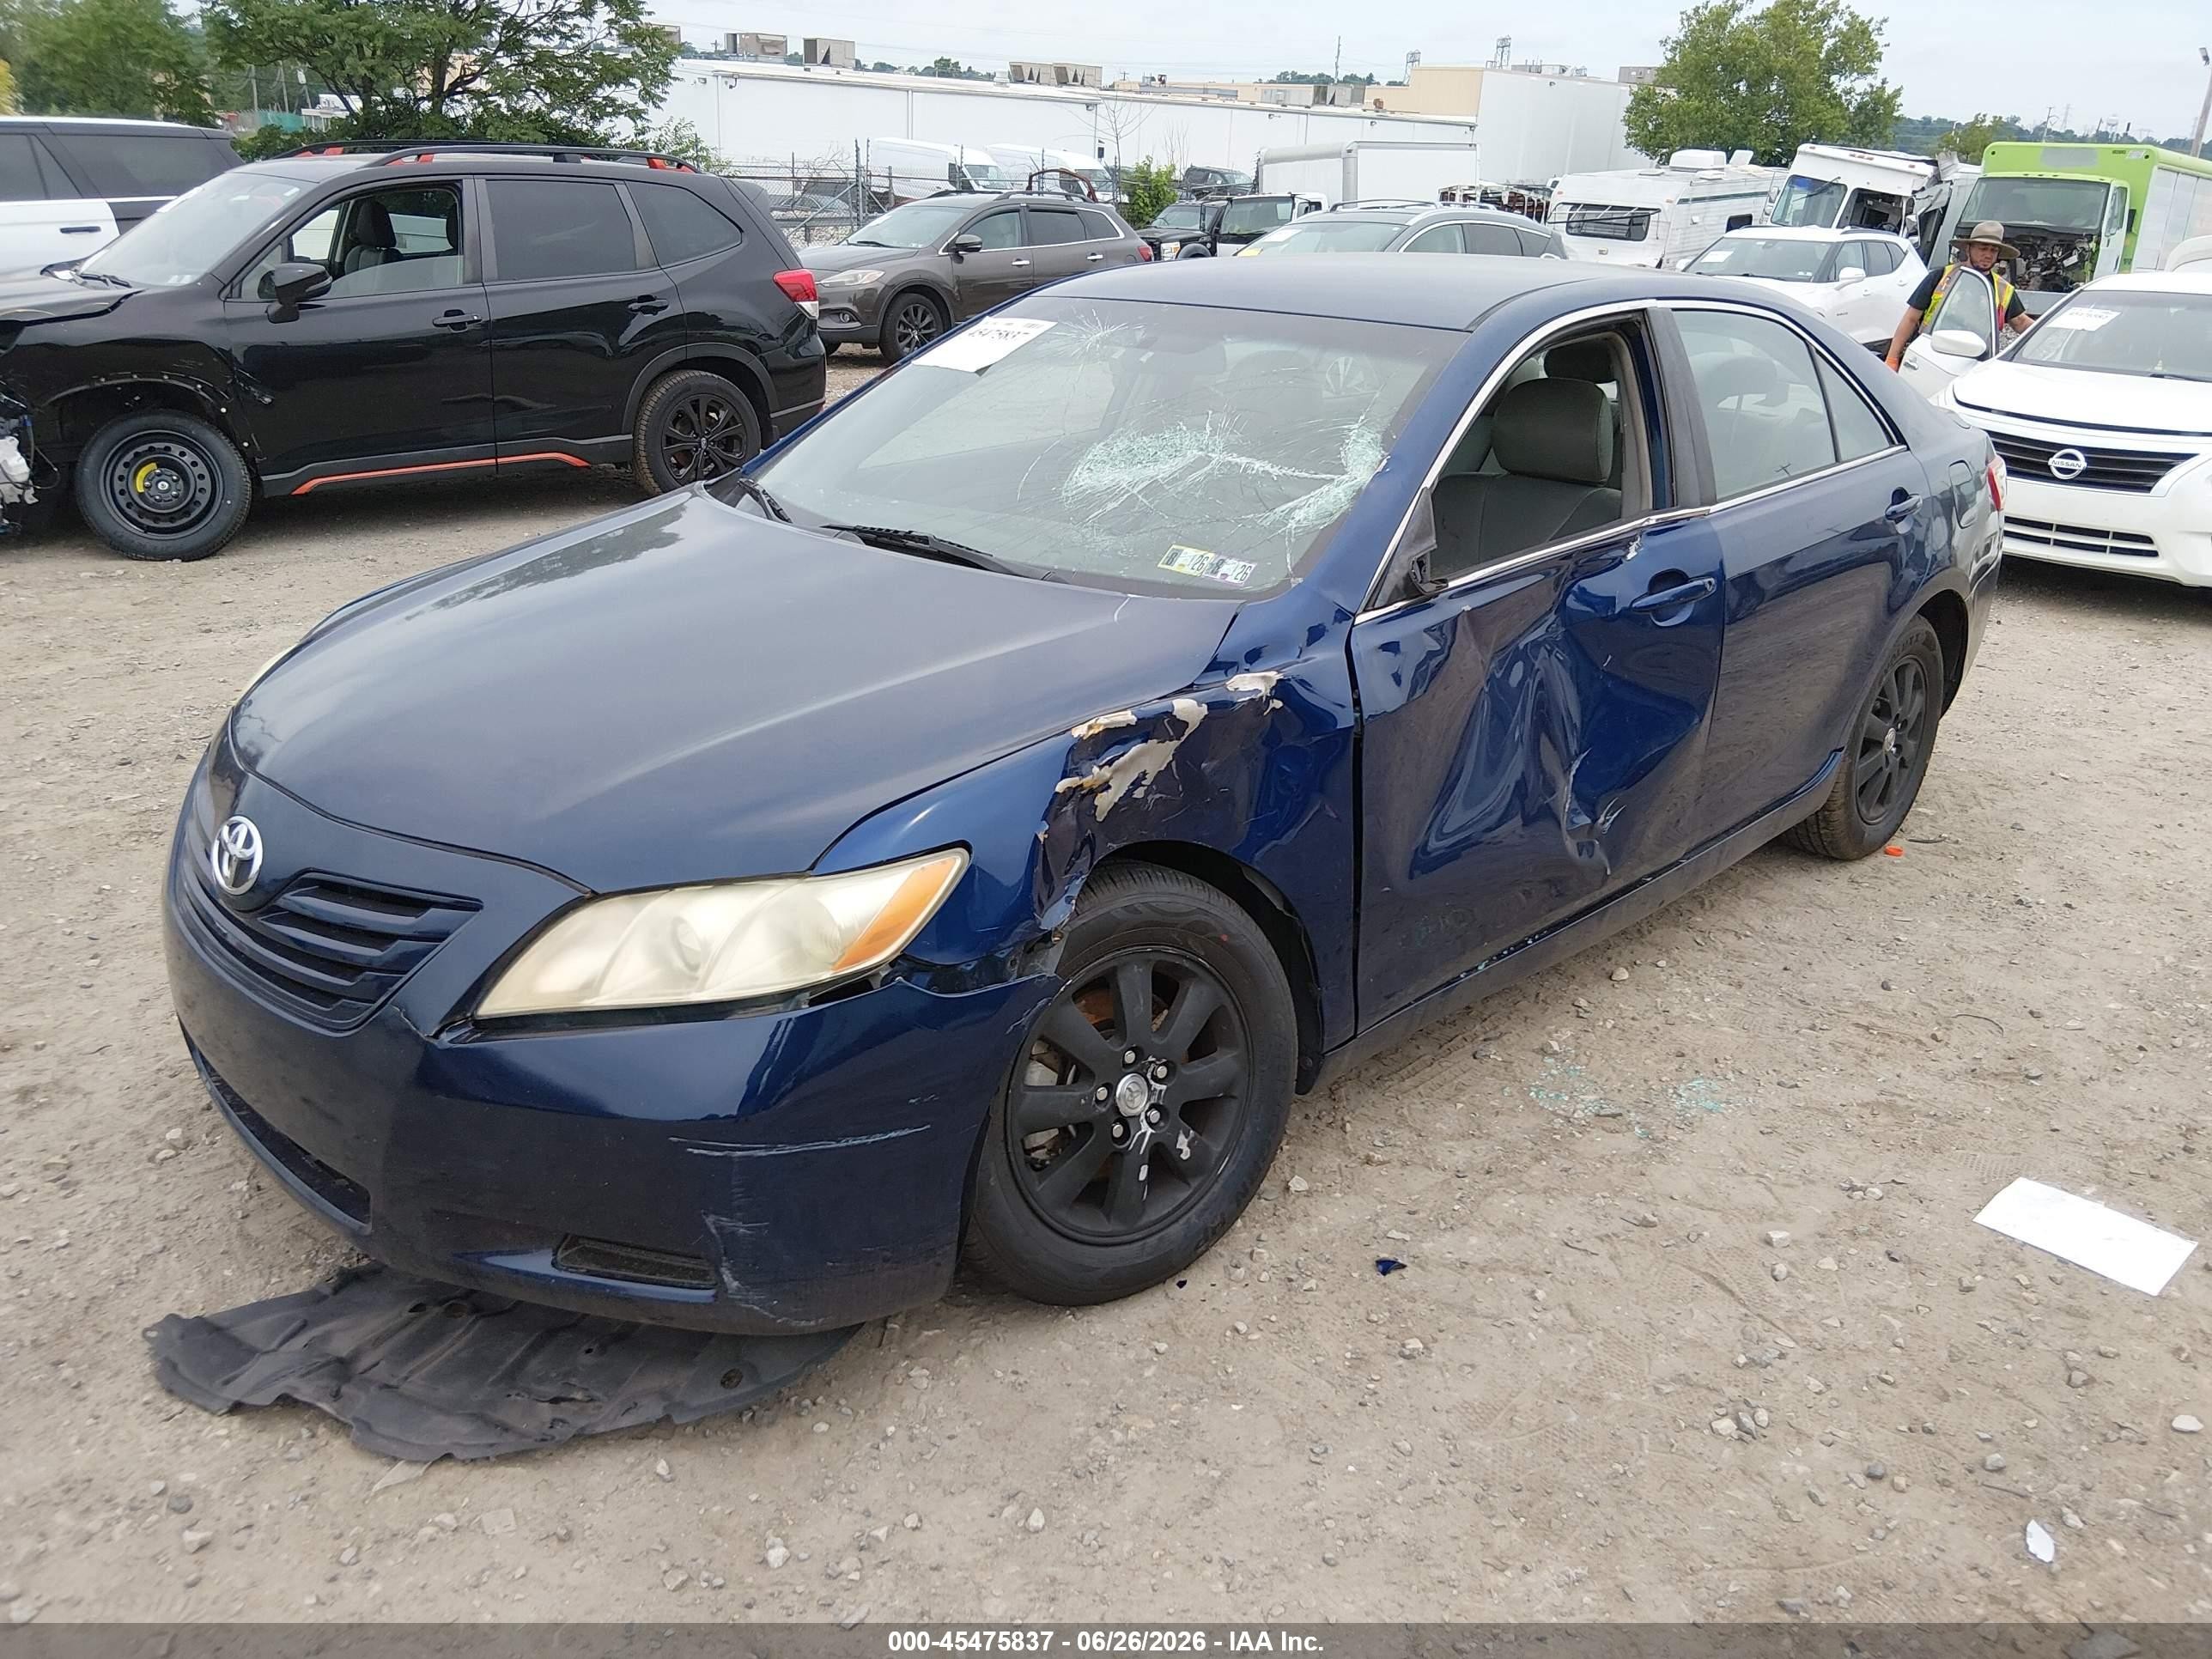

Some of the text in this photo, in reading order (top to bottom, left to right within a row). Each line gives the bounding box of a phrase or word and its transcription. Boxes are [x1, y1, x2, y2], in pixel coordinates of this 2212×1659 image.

[2051, 459, 2082, 469] NISSAN
[1191, 554, 1210, 572] 26
[1234, 564, 1253, 582] 26
